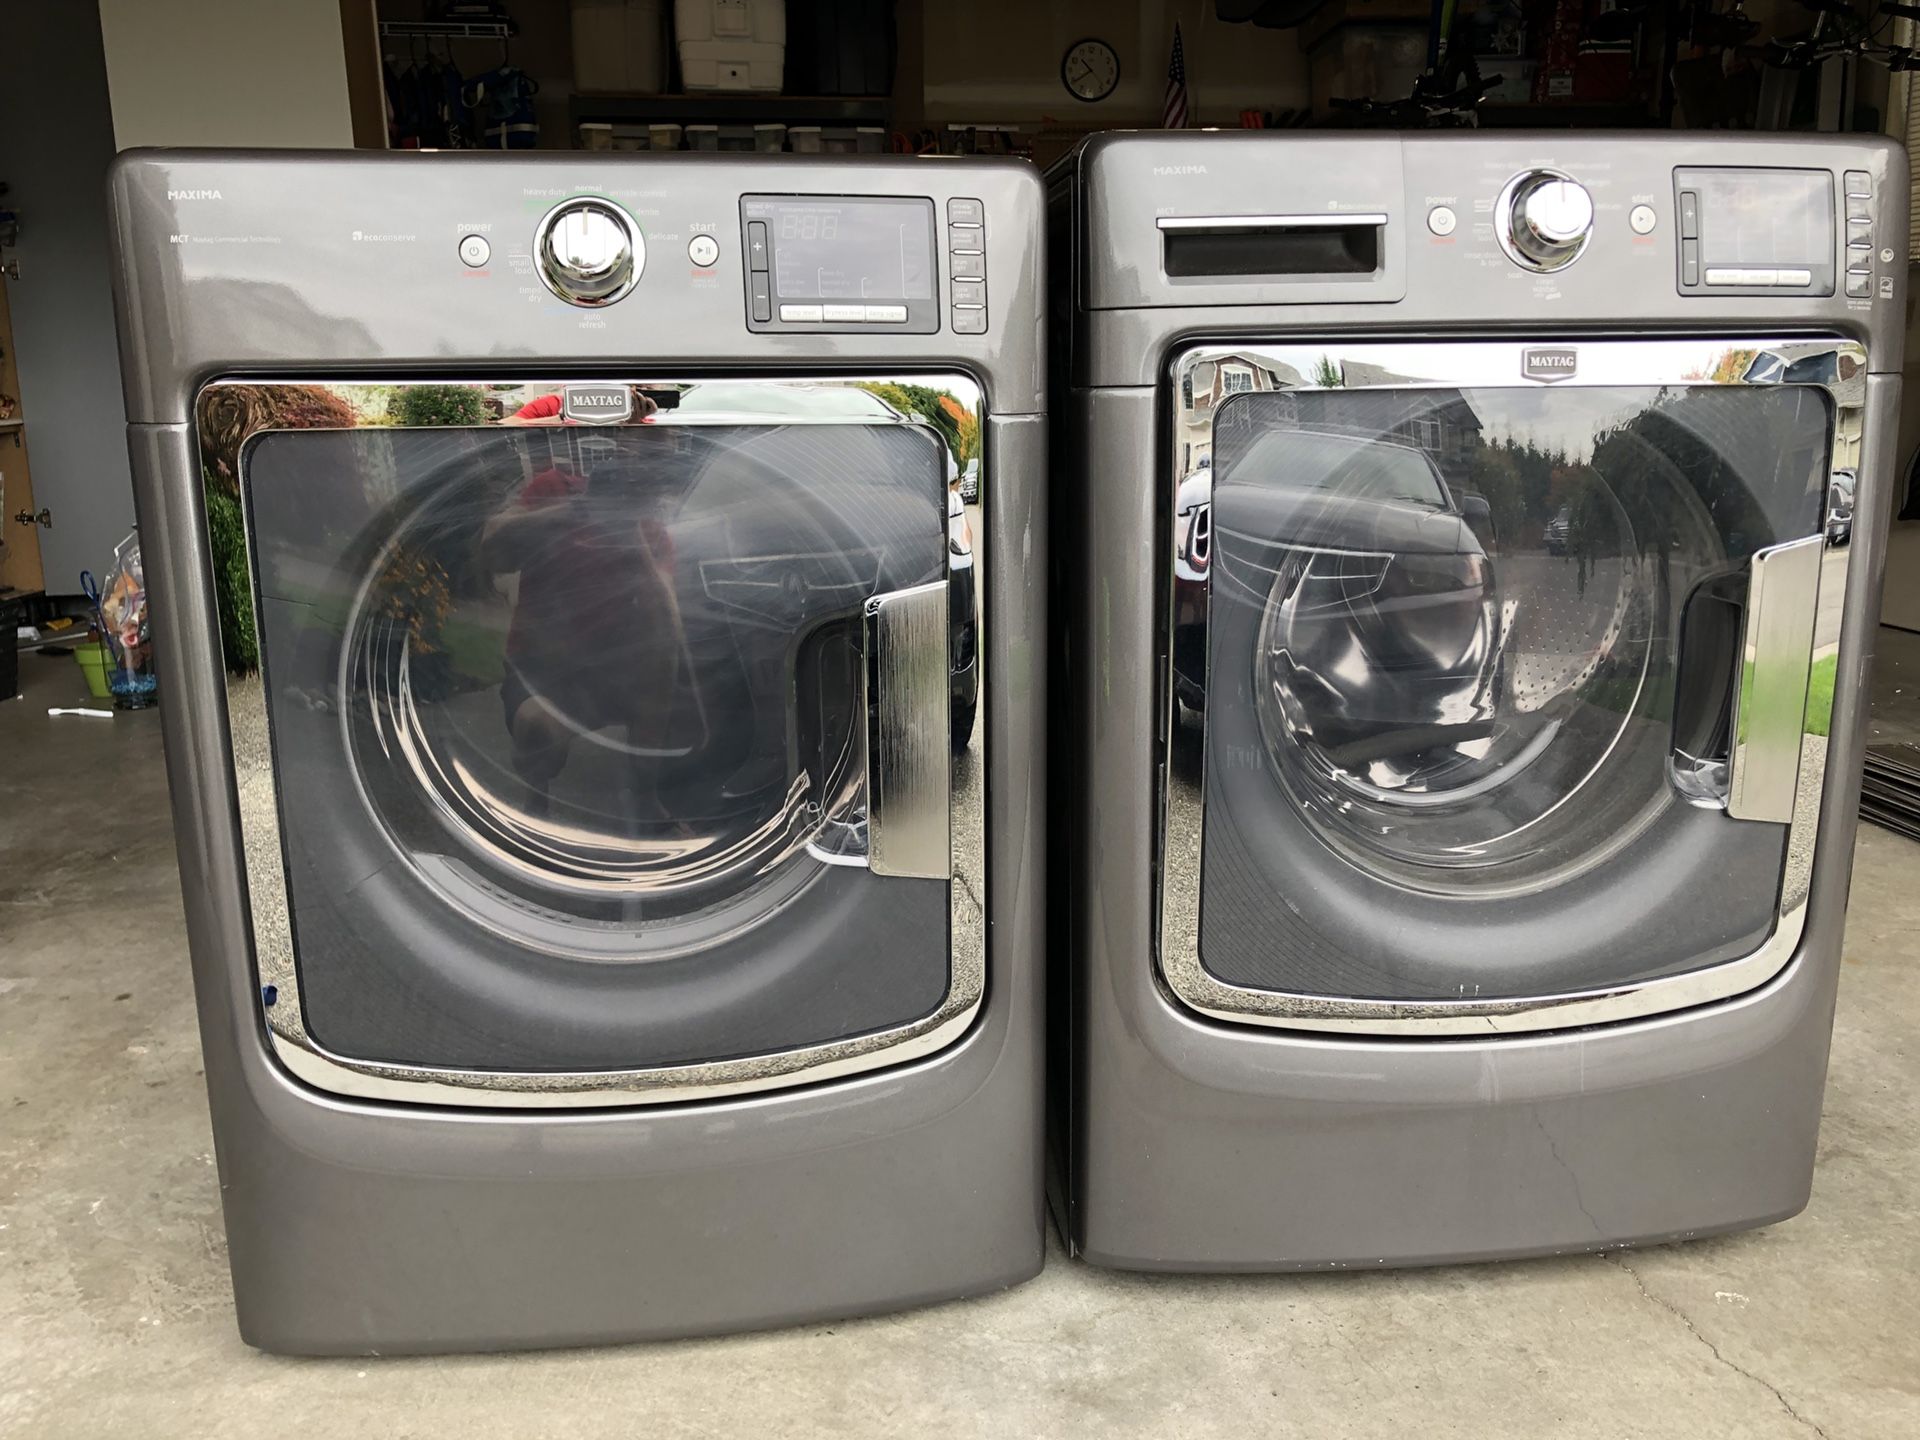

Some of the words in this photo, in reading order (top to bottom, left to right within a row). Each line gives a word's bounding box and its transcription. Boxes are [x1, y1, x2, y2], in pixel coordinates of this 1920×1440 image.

[1153, 165, 1208, 176] MAXIMA
[523, 188, 547, 197] heavy
[549, 188, 567, 197] duty
[574, 184, 603, 193] normal
[167, 190, 223, 200] MAXIMA
[1425, 195, 1458, 206] power
[457, 222, 493, 234] power
[689, 222, 716, 232] start
[169, 234, 190, 244] MCT
[364, 232, 416, 242] ecoconserve
[648, 232, 679, 241] delicate
[519, 286, 542, 295] timed
[528, 294, 542, 303] dry
[583, 313, 601, 321] auto
[578, 321, 606, 329] refresh
[1530, 356, 1574, 367] MAYTAG
[573, 395, 622, 406] MAYTAG
